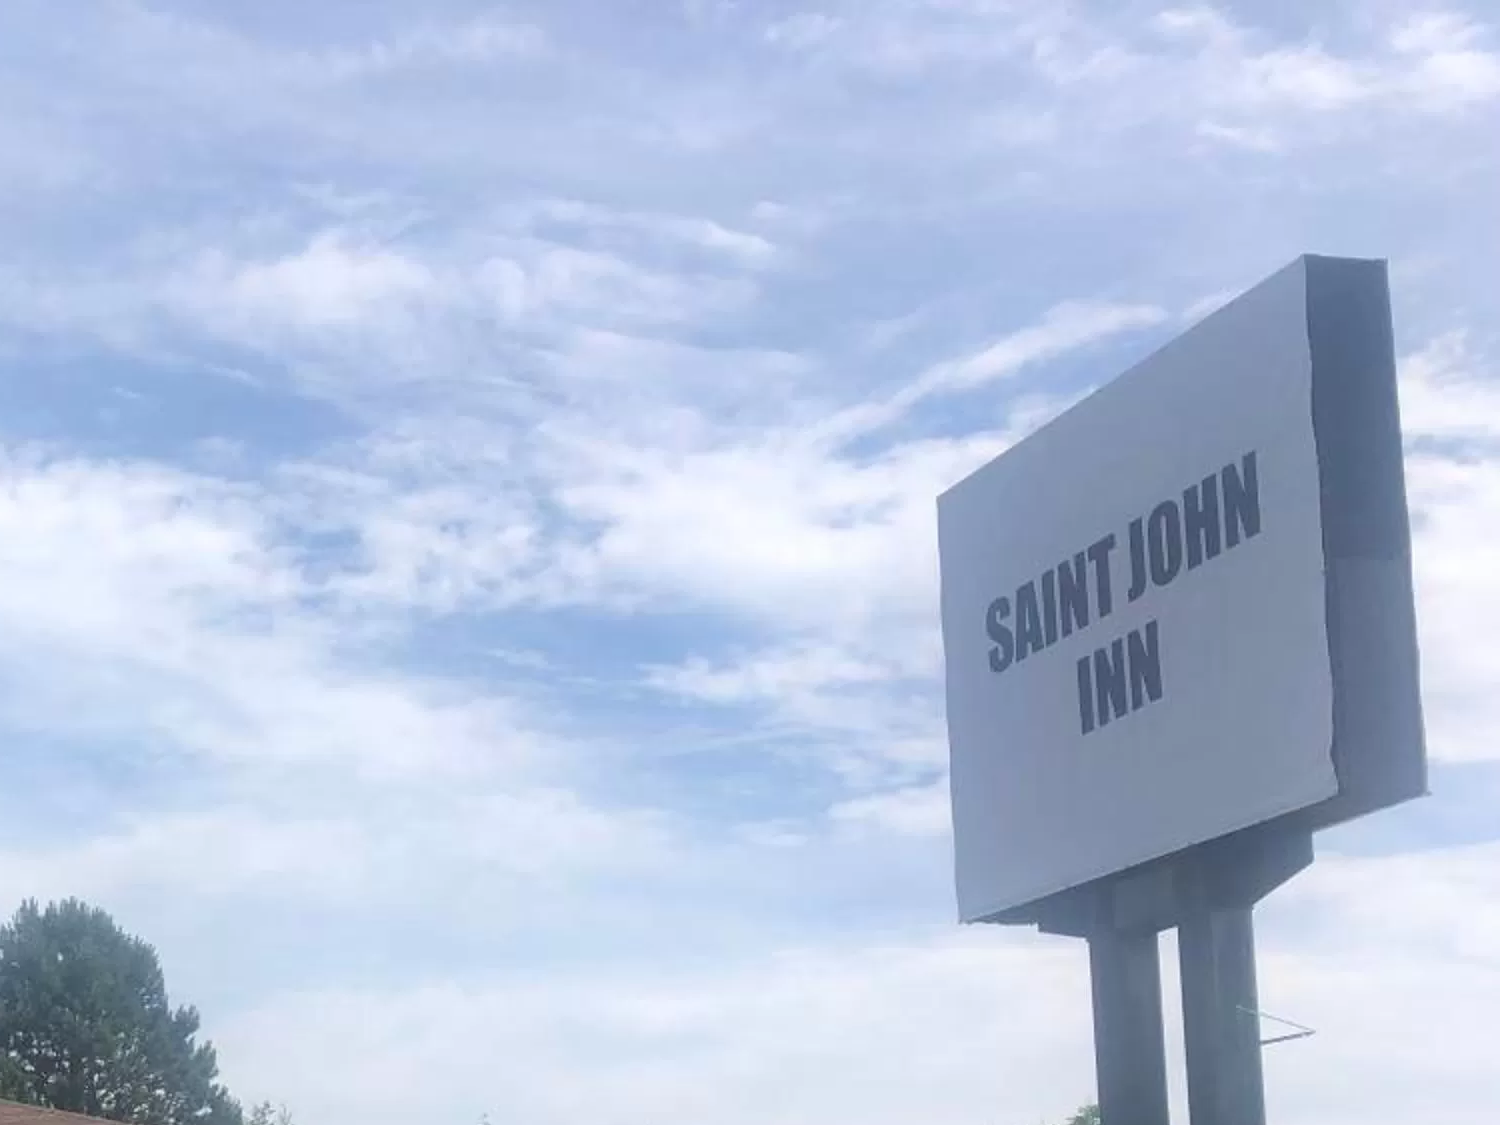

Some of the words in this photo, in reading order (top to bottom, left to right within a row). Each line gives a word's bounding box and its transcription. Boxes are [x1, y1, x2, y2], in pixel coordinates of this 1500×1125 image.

[985, 532, 1117, 674] SAINT
[1127, 449, 1262, 603] JOHN
[1075, 618, 1164, 736] INN
